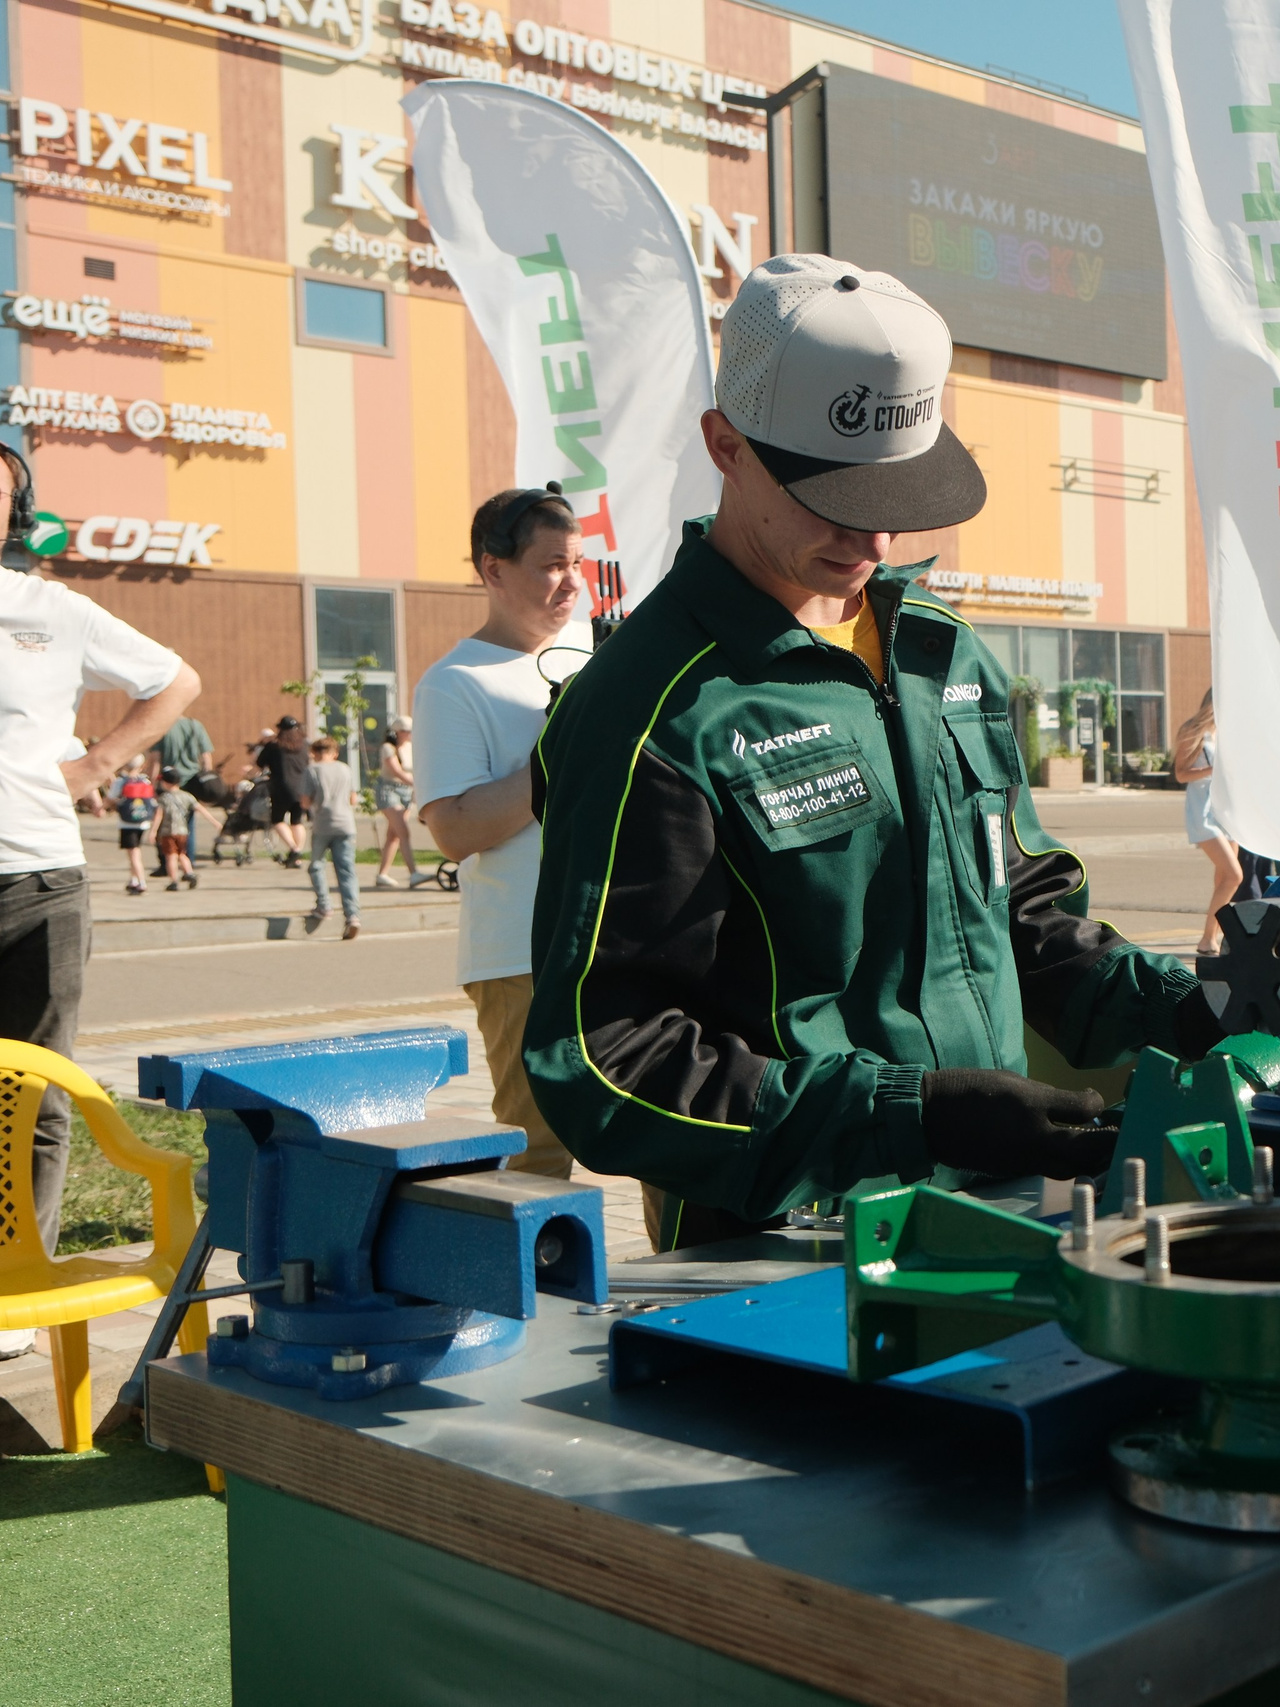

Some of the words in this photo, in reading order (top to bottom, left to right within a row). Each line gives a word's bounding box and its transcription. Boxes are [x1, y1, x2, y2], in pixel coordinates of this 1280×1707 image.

[401, 0, 509, 48] БАЗА
[513, 19, 697, 99] ОПТОВЫХ
[20, 96, 233, 192] PIXEL
[908, 178, 1016, 227] ЗАКАЖИ
[1024, 208, 1104, 249] ЯРКУЮ
[332, 229, 403, 266] shop
[409, 244, 450, 271] clo
[908, 213, 1104, 302] ВЫВЕСКУ
[9, 385, 120, 415] АПТЕКА
[170, 403, 272, 429] ПЛАНЕТА
[170, 421, 287, 449] ЗДОРОВЬЯ
[75, 515, 222, 566] CDEK
[751, 723, 832, 755] TATNEFT
[760, 782, 814, 807] ГОРЯЧАЯ
[816, 767, 861, 791] ЛИНИЯ
[769, 782, 867, 822] 8-800-100-41-12
